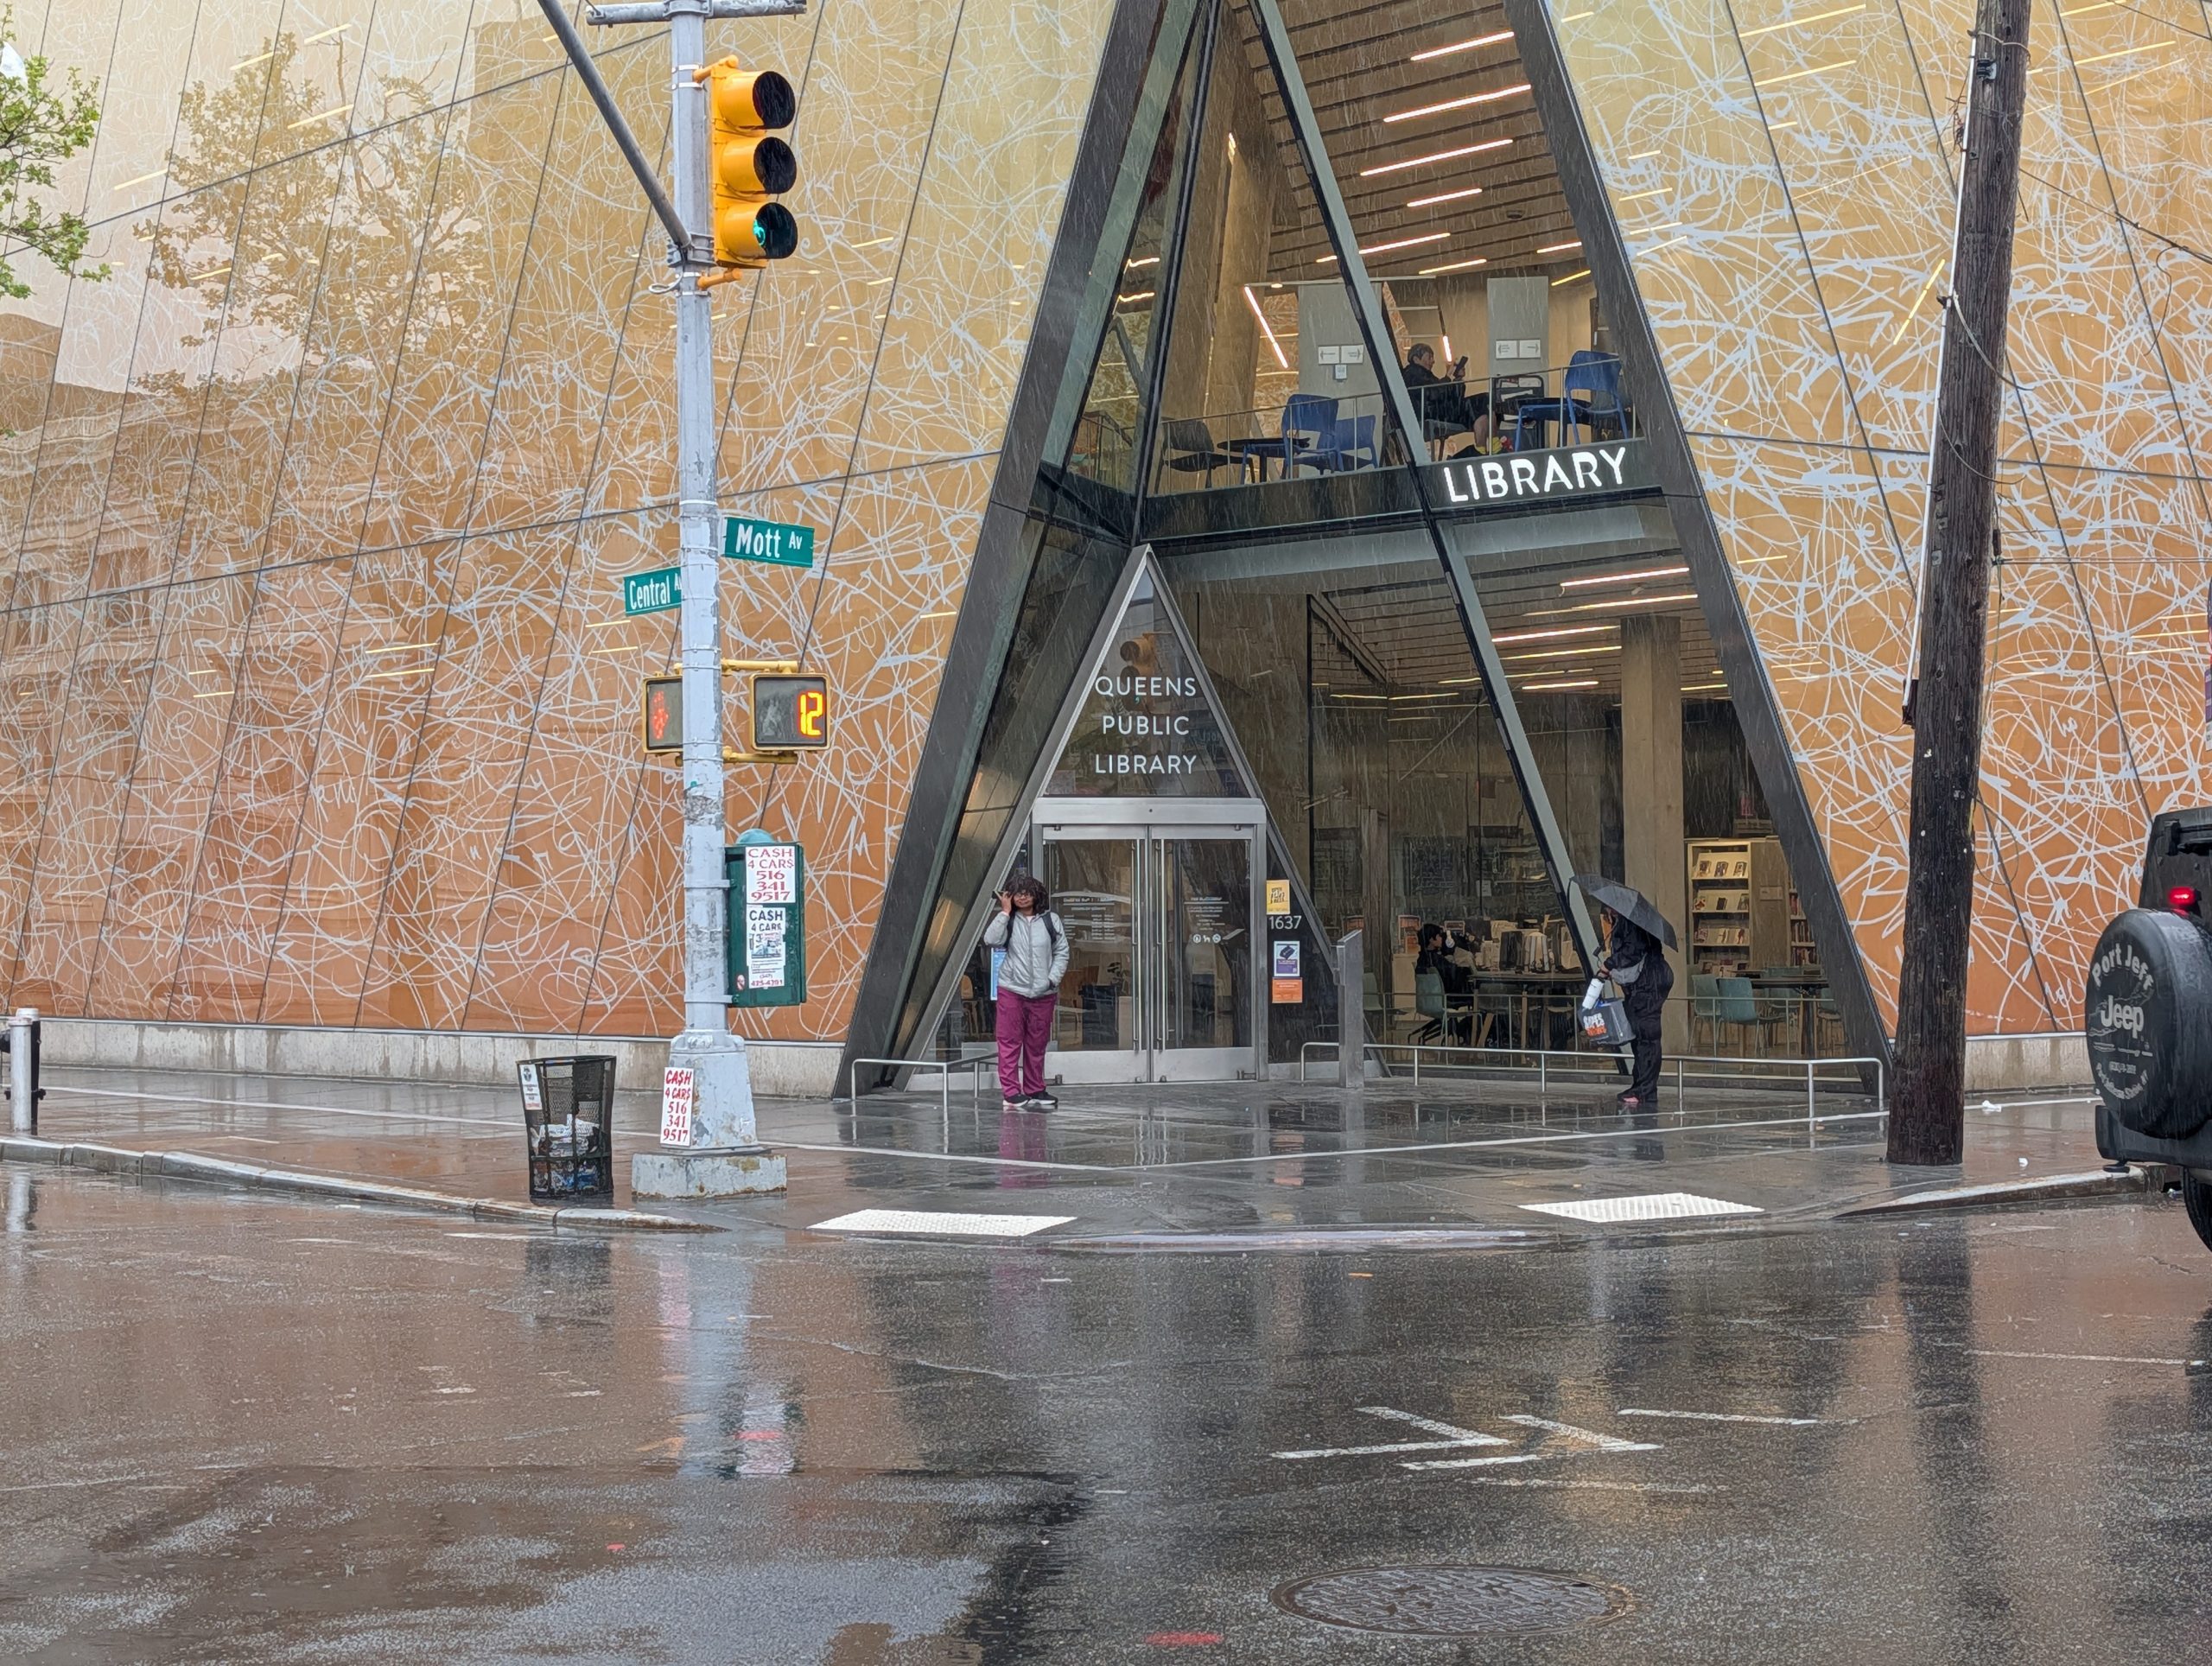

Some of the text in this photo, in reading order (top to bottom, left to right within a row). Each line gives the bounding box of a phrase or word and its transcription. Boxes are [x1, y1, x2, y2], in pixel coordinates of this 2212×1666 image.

[1444, 447, 1626, 503] LIBRARY
[736, 524, 803, 558] Mott Av
[629, 575, 671, 610] Central
[1095, 676, 1197, 697] QUEENS
[800, 692, 823, 735] 12
[1103, 715, 1189, 735] PUBLIC
[1095, 754, 1197, 774] LIBRARY
[747, 859, 755, 869] 4
[756, 869, 785, 881] 516
[756, 881, 785, 892] 341
[751, 891, 791, 902] 9517
[751, 922, 757, 932] 4
[1268, 915, 1302, 930] 1637
[2092, 943, 2154, 990] Port Jeff
[2101, 995, 2144, 1039] Jeep
[665, 1087, 671, 1099] 4
[667, 1101, 688, 1114] 516
[666, 1115, 686, 1129] 341
[663, 1128, 689, 1142] 9517
